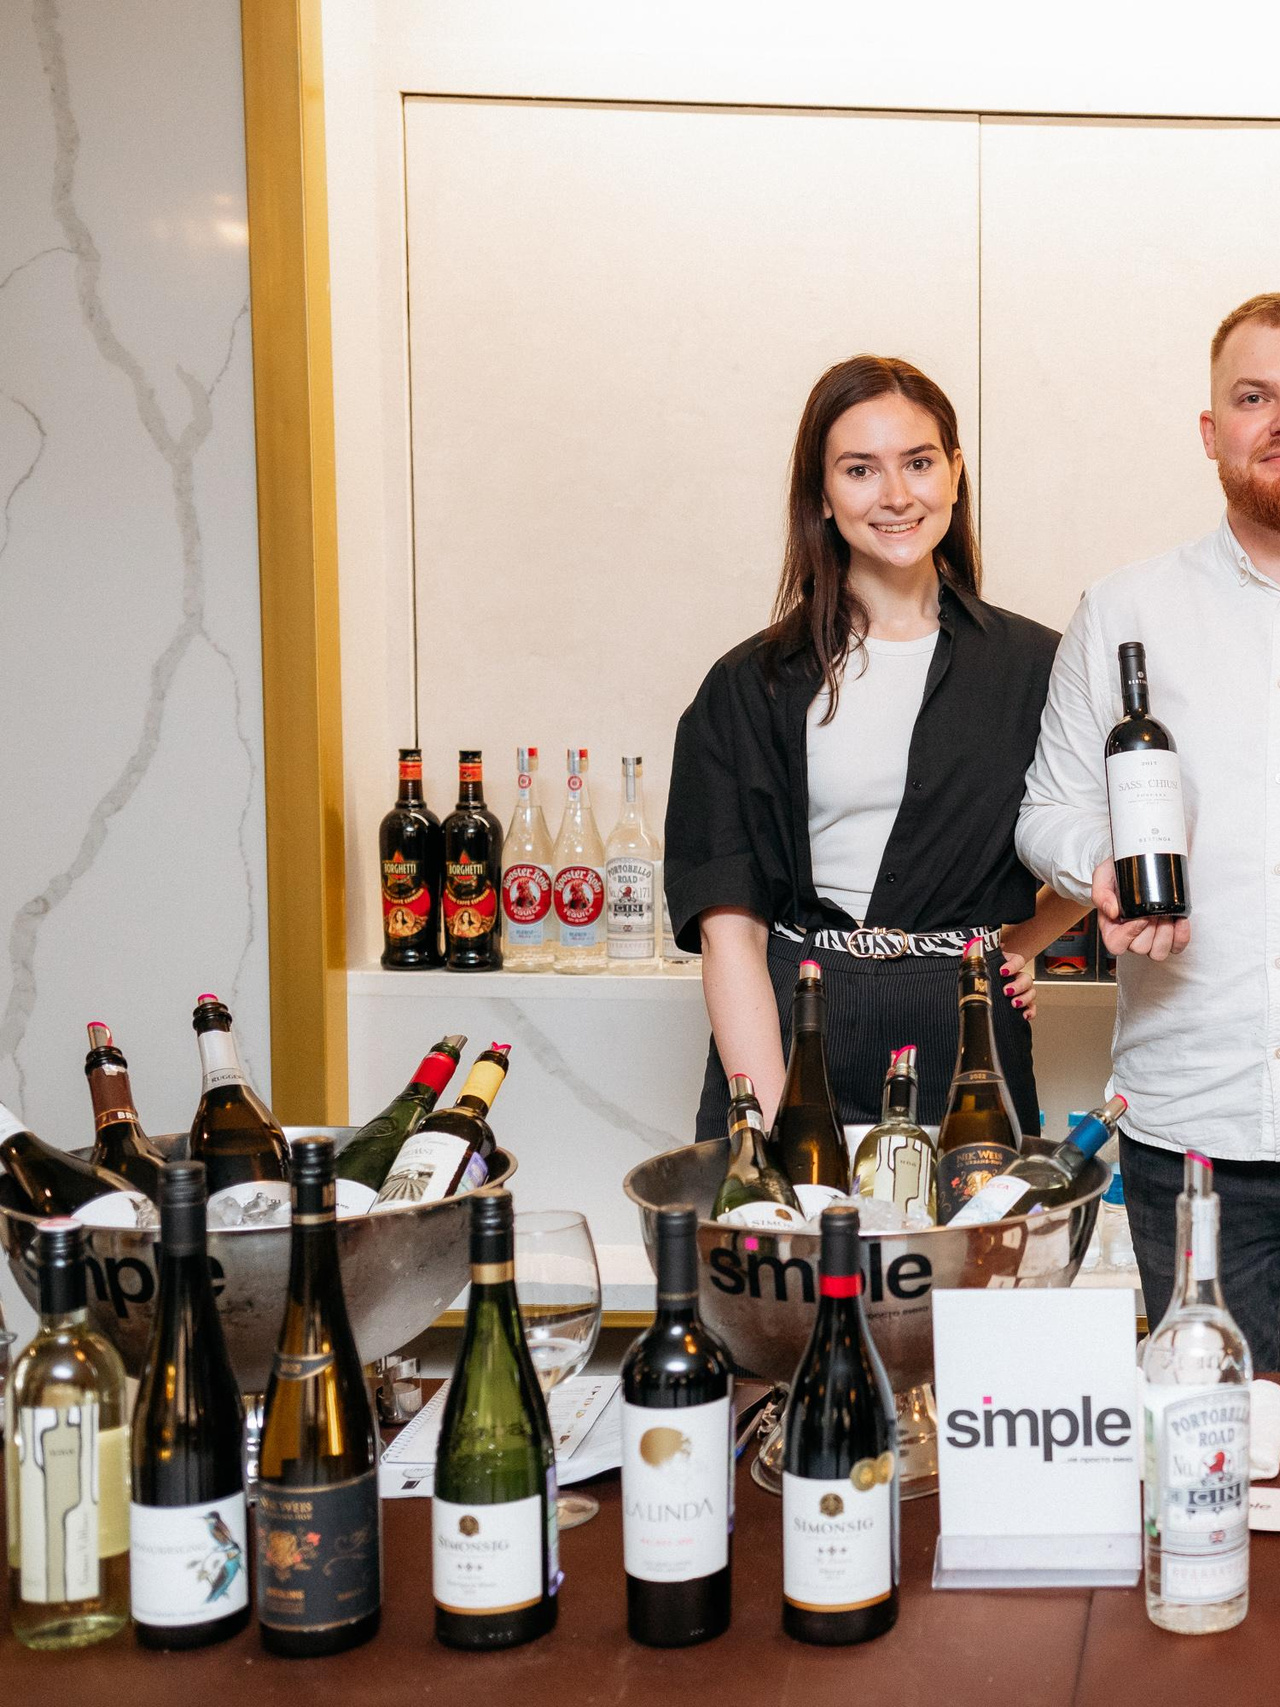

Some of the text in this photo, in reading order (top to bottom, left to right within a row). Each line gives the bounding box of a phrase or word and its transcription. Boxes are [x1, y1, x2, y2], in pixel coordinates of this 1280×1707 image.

[1118, 780, 1142, 792] SASS
[384, 862, 417, 875] BORGHETTI
[449, 863, 484, 875] BORGHETTI
[607, 864, 652, 879] PORTOBELLO
[617, 875, 638, 884] ROAD
[709, 1237, 932, 1303] simle
[946, 1395, 1132, 1463] simple
[1171, 1405, 1250, 1437] PORTOBELL
[1198, 1428, 1236, 1448] ROAD
[1187, 1483, 1241, 1506] GIN
[793, 1517, 874, 1535] SIMONSIG
